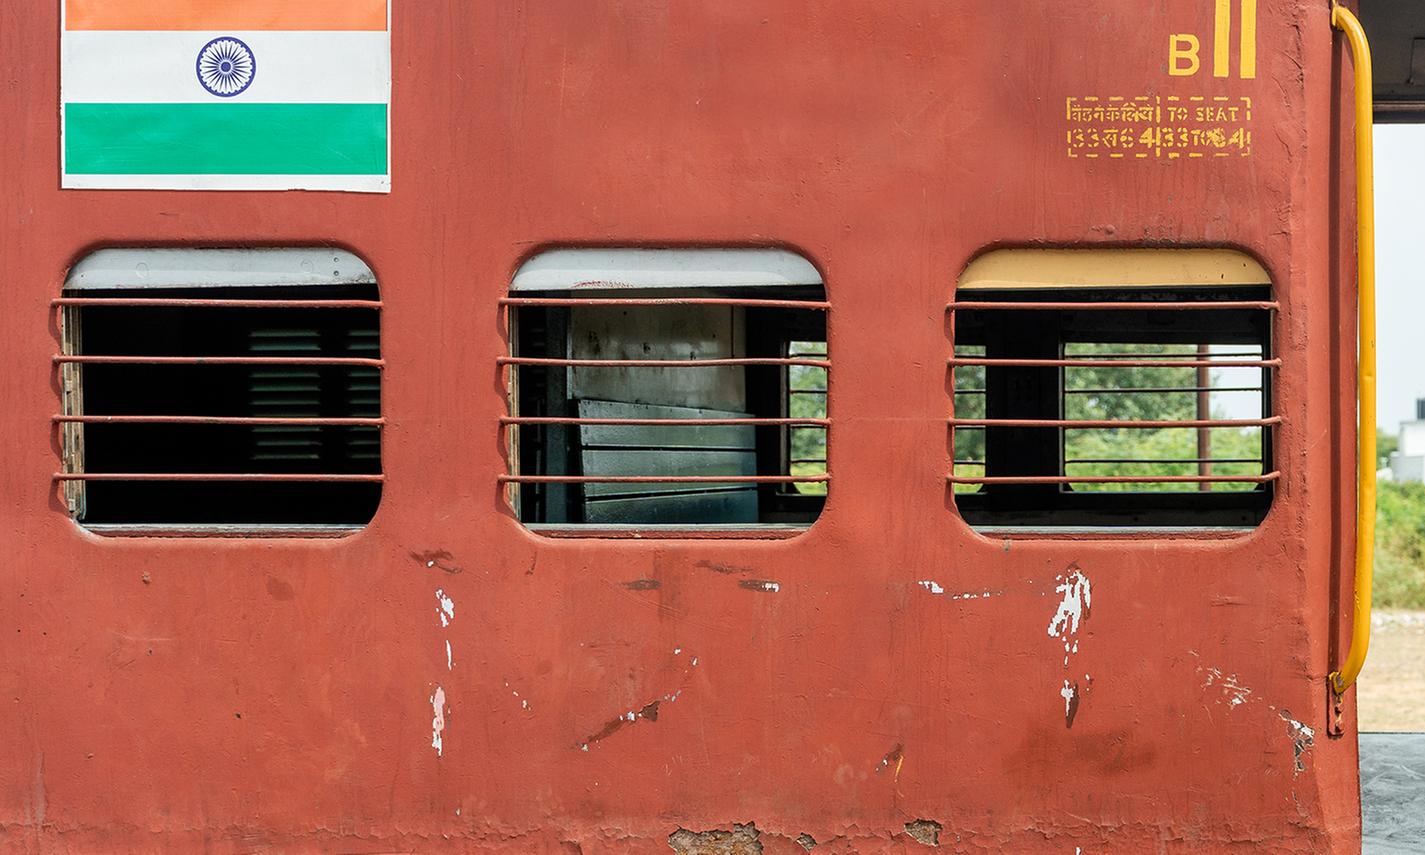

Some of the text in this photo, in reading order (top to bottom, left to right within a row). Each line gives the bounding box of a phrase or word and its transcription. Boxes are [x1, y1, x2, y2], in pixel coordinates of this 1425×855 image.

[1168, 33, 1200, 76] B
[1167, 107, 1239, 122] TO SEAT
